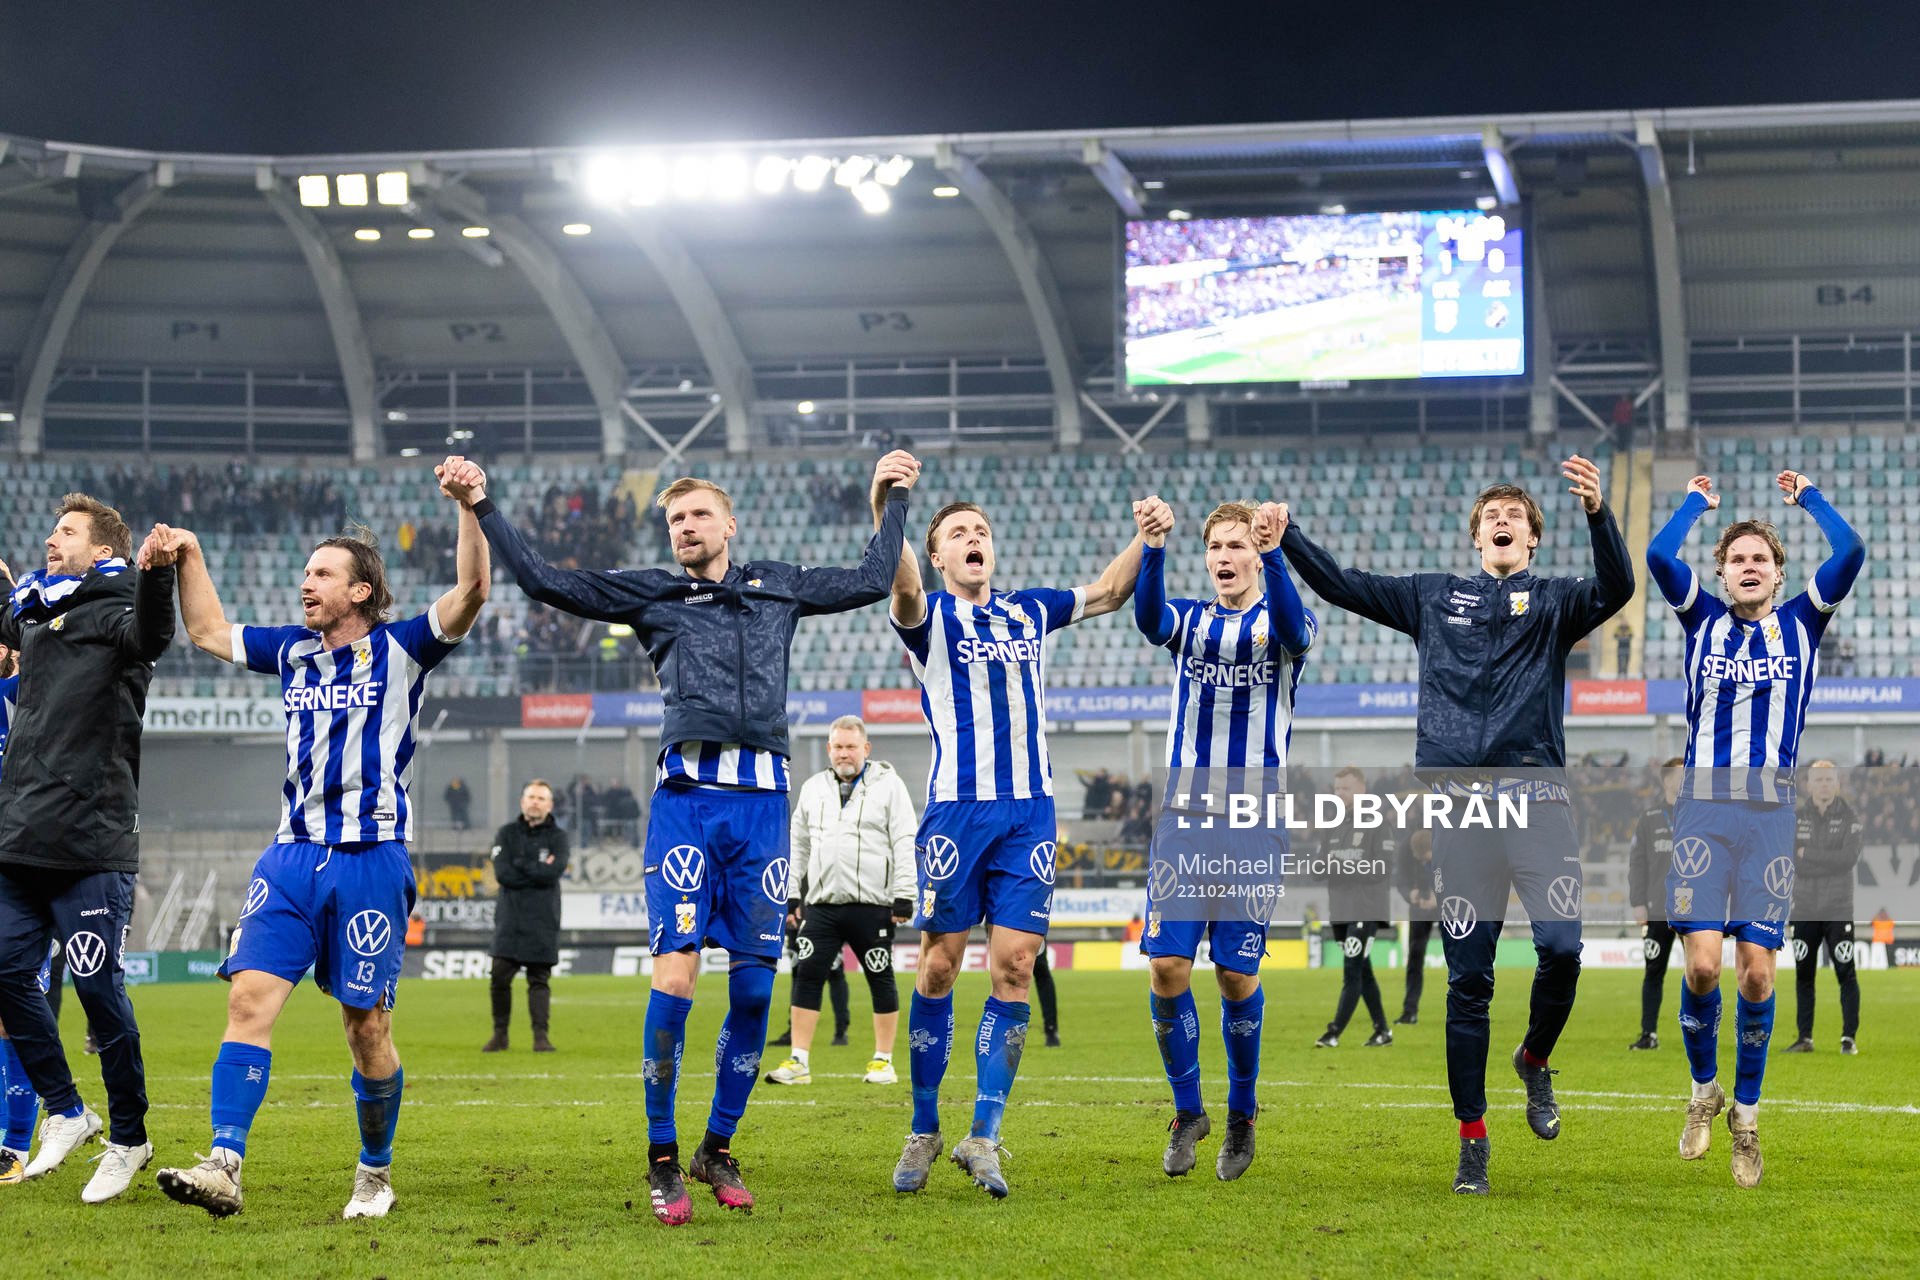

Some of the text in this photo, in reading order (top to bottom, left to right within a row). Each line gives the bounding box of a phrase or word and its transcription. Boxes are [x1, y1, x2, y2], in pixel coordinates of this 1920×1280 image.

[1817, 283, 1874, 306] B4
[1184, 656, 1275, 687] SERNEKE
[1702, 654, 1794, 682] SERNEKE
[284, 681, 379, 713] SERNEKE
[662, 845, 705, 892] VW
[924, 835, 960, 880] VW
[1673, 837, 1711, 879] VW
[80, 909, 103, 917] CRAFT
[1763, 902, 1782, 924] 14
[347, 910, 391, 957] VW
[1241, 931, 1262, 952] 20
[1751, 921, 1774, 934] CRAFT
[66, 931, 107, 977] VW
[356, 960, 375, 983] 13
[347, 982, 367, 993] CRAFT
